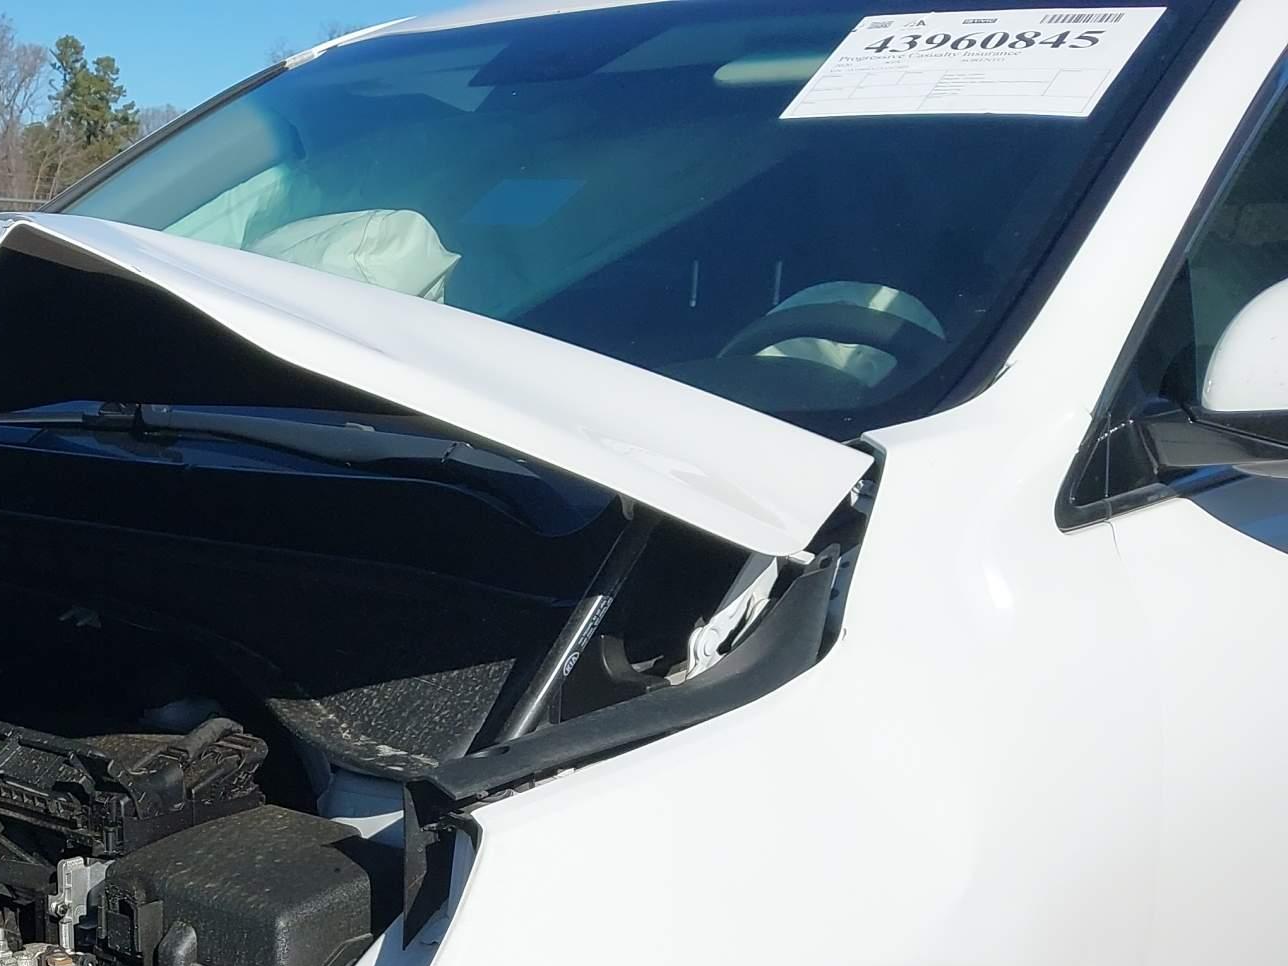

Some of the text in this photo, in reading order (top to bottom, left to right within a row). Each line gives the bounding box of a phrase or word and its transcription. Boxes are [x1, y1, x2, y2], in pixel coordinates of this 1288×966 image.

[864, 30, 1107, 53] 43960845
[839, 50, 1023, 63] Progressive Casualty Insurance
[565, 656, 577, 673] KIA
